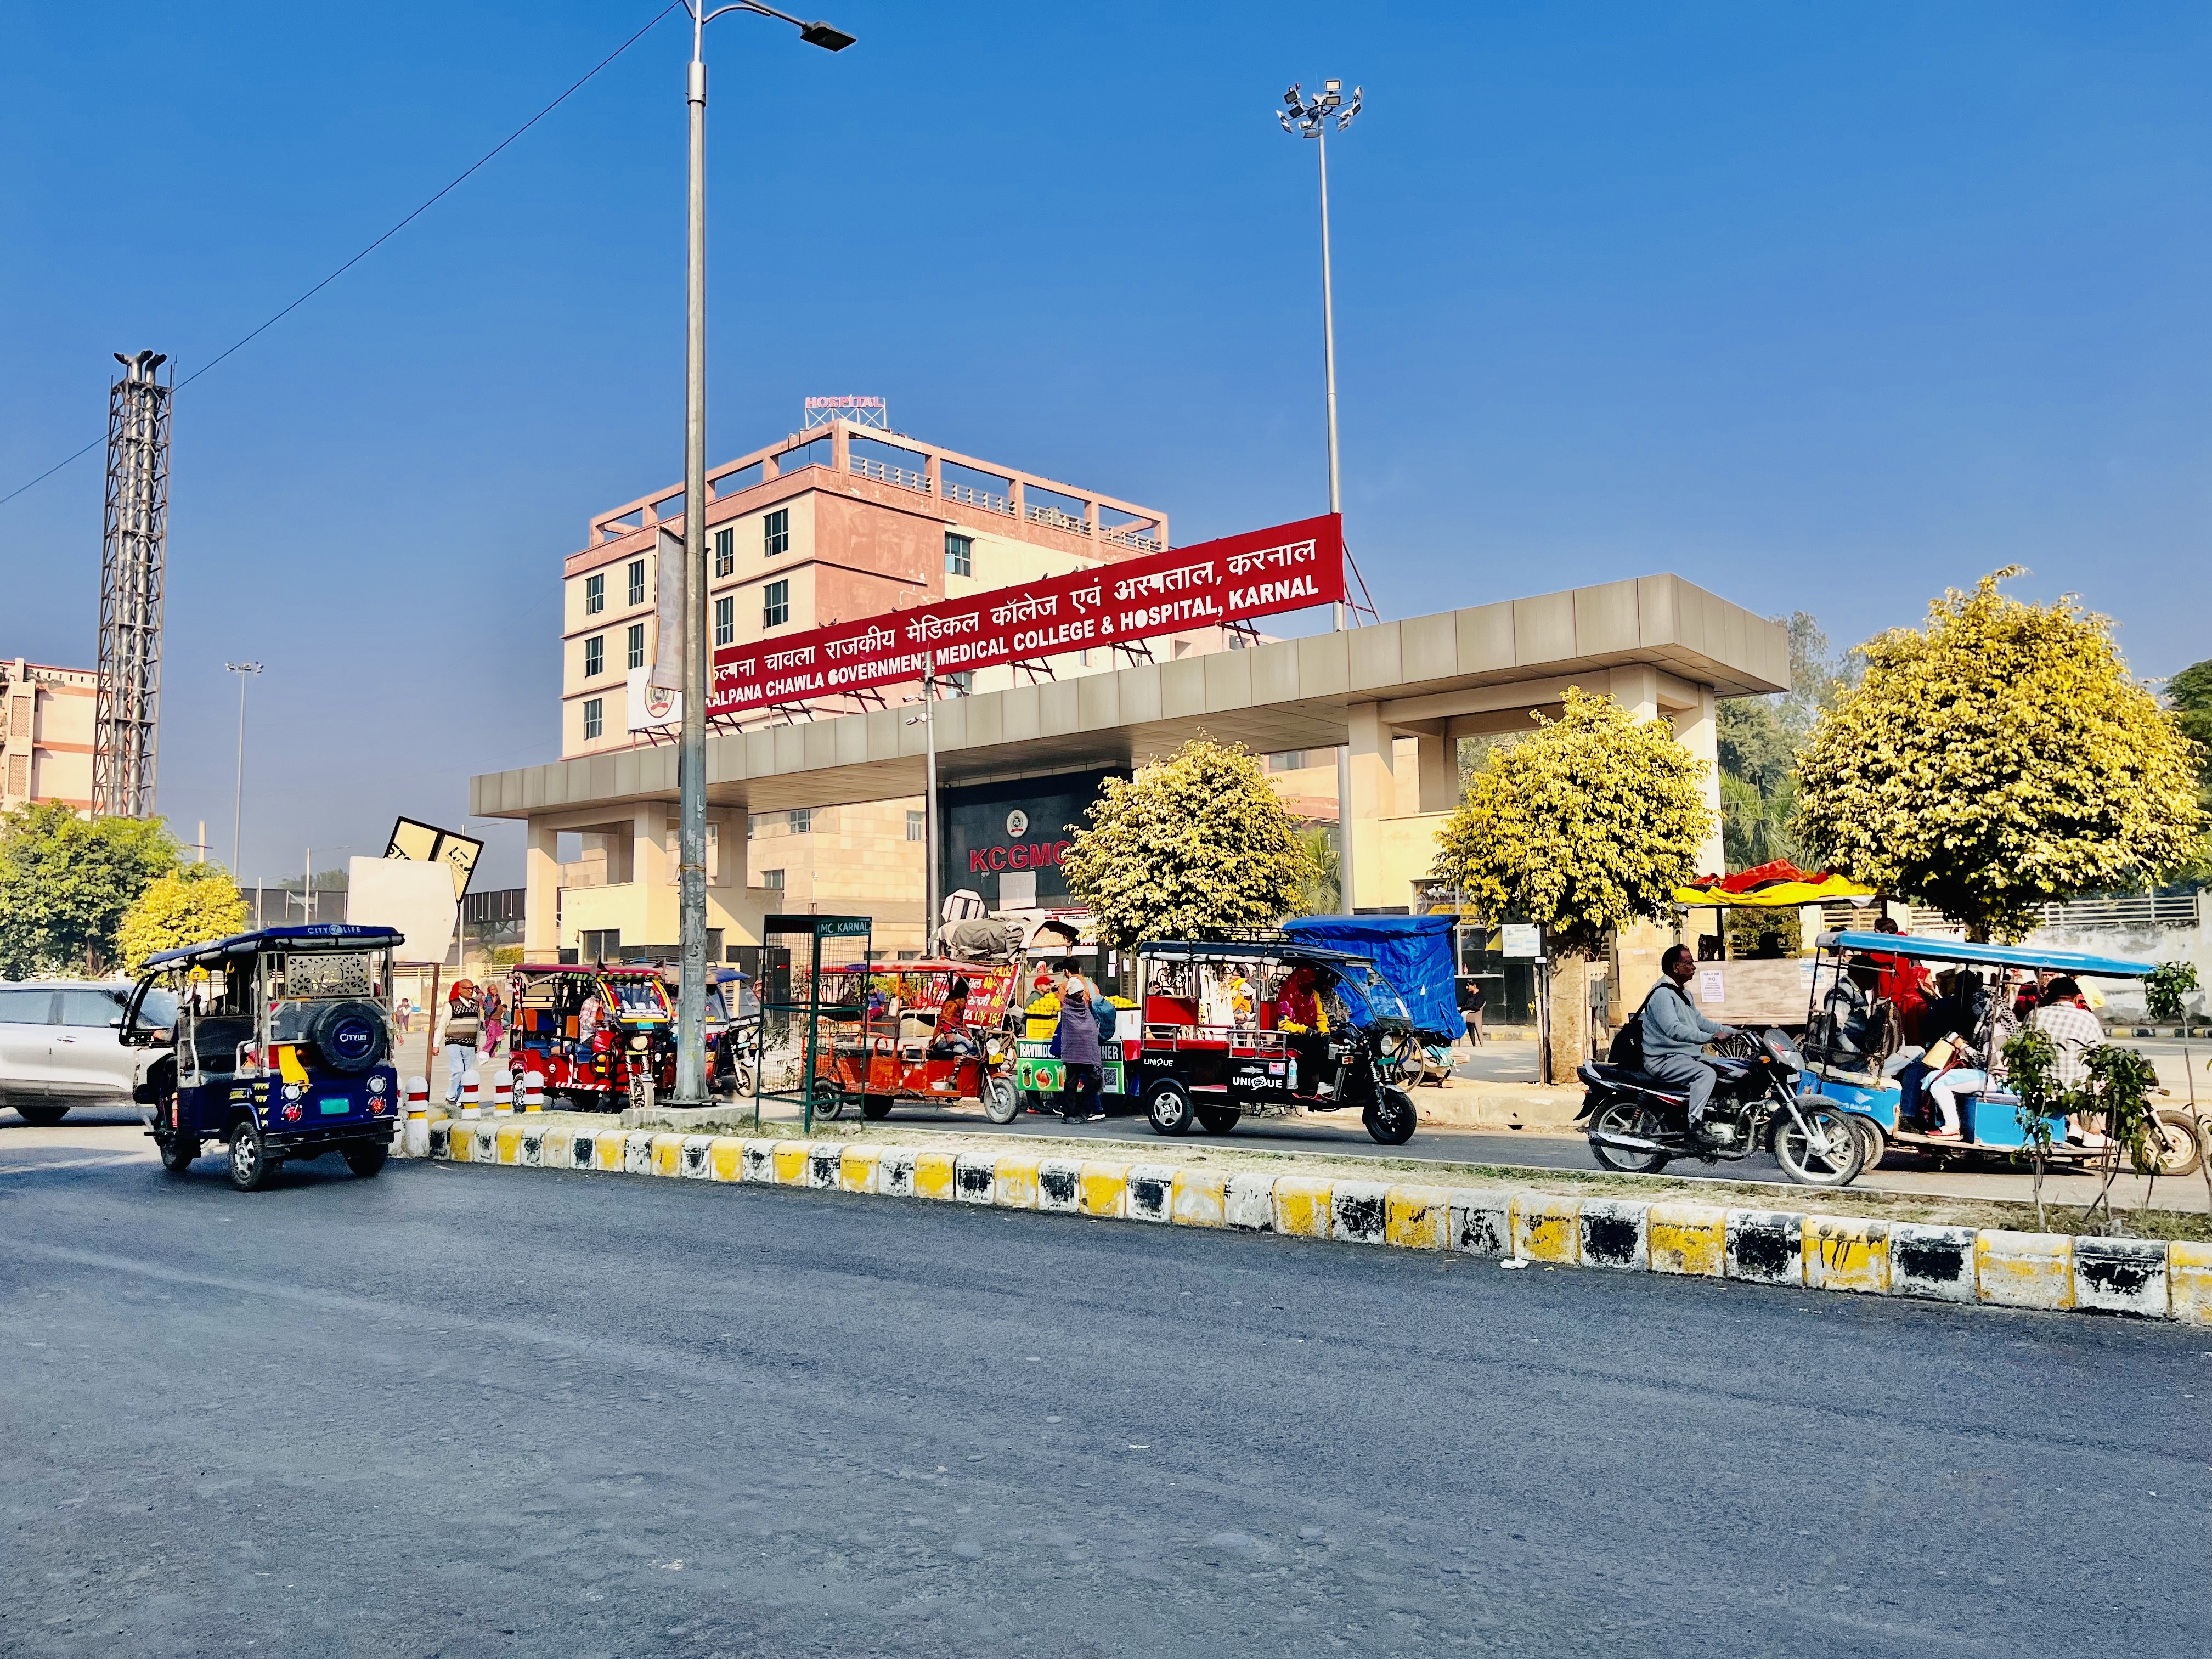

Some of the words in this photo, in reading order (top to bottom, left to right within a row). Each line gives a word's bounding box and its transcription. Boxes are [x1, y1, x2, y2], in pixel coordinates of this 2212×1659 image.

[805, 396, 884, 408] HOSPITAL
[764, 646, 816, 671] चावला
[824, 625, 896, 659] राजकीय
[906, 614, 980, 643] मेडिकल
[990, 592, 1058, 627] कॉलेज
[1070, 577, 1102, 614] एवं
[1114, 561, 1222, 600] अस्पताल,
[1226, 538, 1317, 576] करनाल
[766, 672, 825, 697] CHAWLA
[828, 651, 932, 686] GOVERNMEN
[936, 637, 1009, 666] MEDICAL
[1013, 619, 1095, 651] COLLEGE
[1101, 616, 1114, 635] &
[1120, 595, 1223, 631] HOSPITAL,
[1229, 575, 1319, 610] KARNAL
[821, 923, 834, 933] MC
[837, 922, 869, 933] KARNAL
[990, 995, 1004, 1008] 40/-
[1019, 1043, 1056, 1058] RAVINDE
[1144, 1058, 1173, 1067] UNIQUE
[1233, 1076, 1283, 1091] UNIQUE
